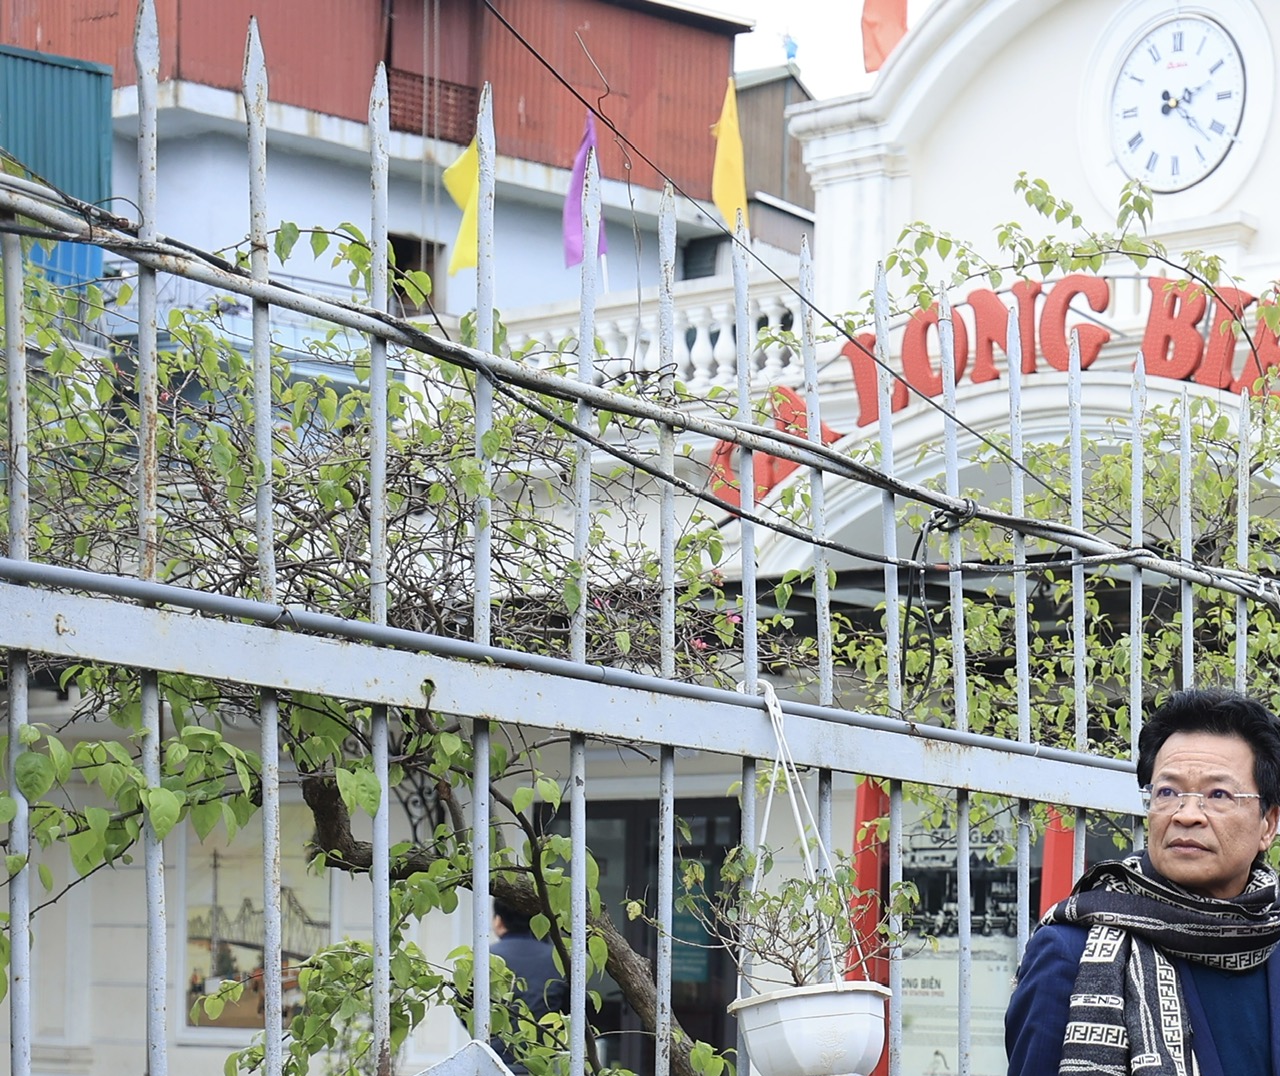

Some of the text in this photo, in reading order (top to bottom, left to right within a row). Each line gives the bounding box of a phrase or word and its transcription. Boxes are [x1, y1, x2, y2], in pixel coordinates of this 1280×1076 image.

[842, 274, 1111, 427] LONG
[901, 975, 941, 990] ONG BIÊN
[1071, 995, 1124, 1005] FENDI
[1132, 1055, 1159, 1068] NDI
